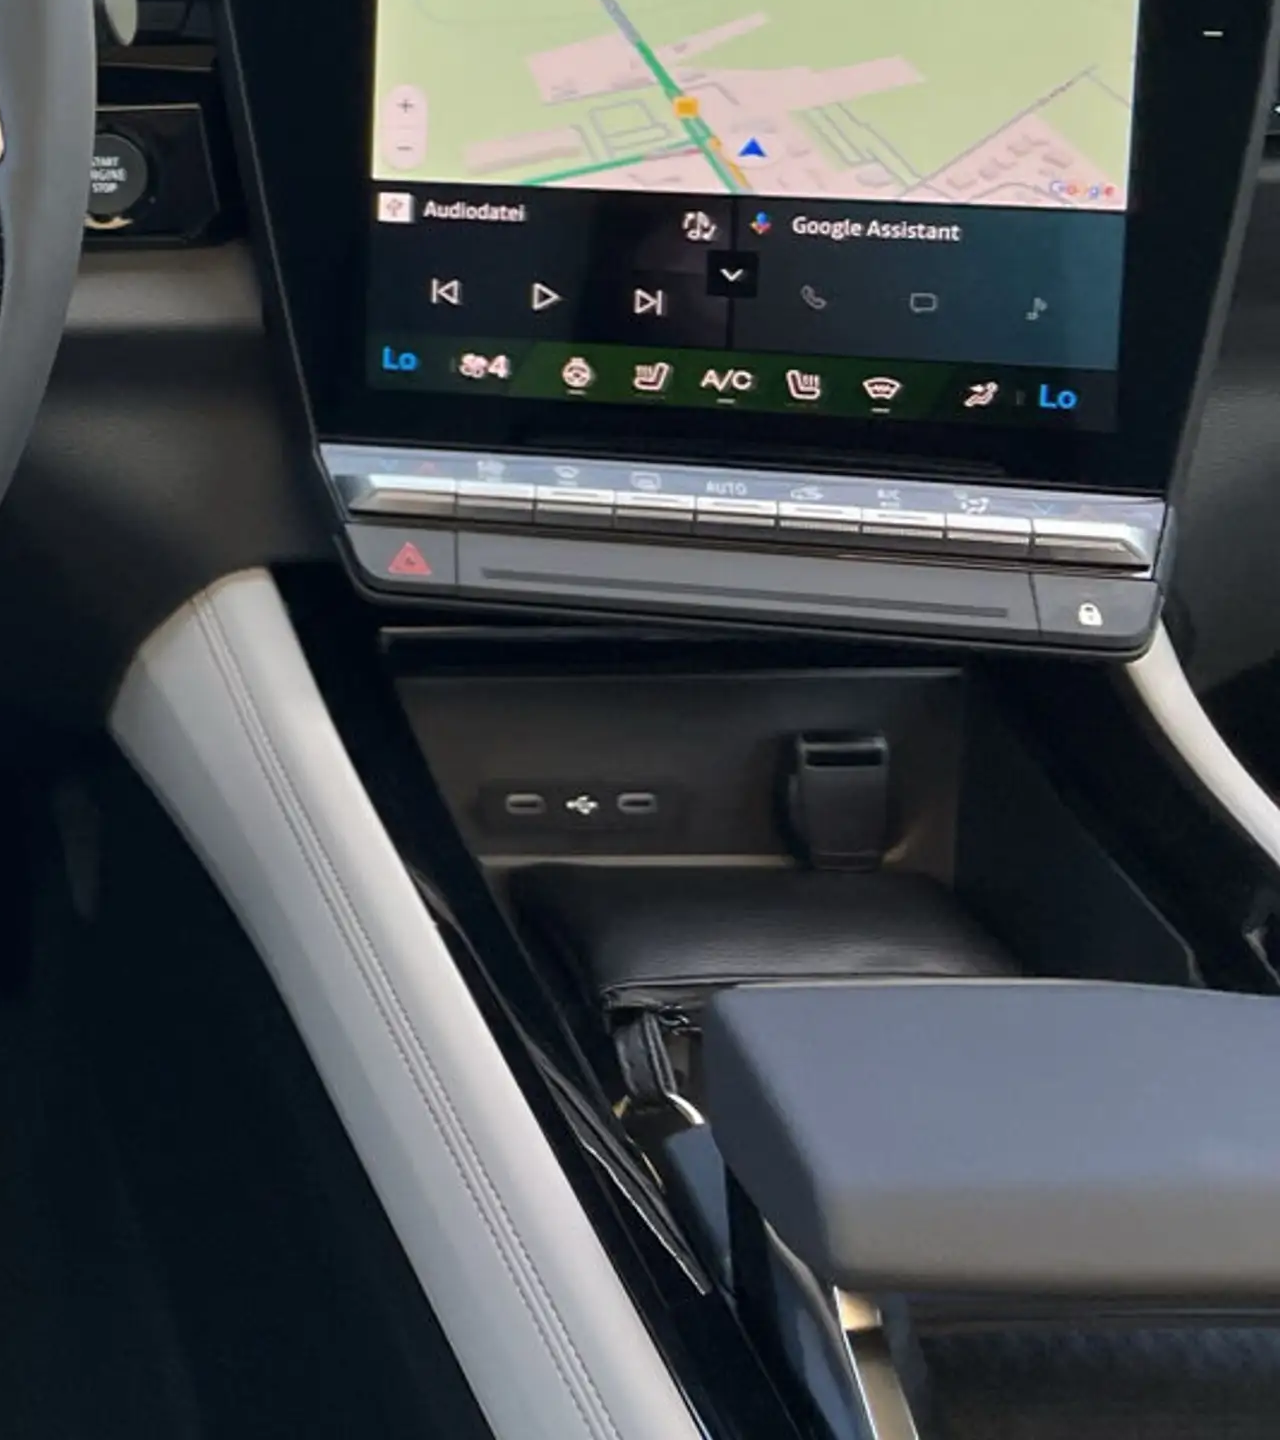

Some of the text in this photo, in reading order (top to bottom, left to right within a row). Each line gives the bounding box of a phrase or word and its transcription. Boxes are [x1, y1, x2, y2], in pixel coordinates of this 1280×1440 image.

[423, 200, 527, 222] Audiodatei
[792, 215, 962, 242] Google Assistant
[382, 345, 418, 372] Lo
[700, 368, 755, 393] A/C
[1039, 383, 1078, 411] Lo
[705, 479, 748, 497] AUTO
